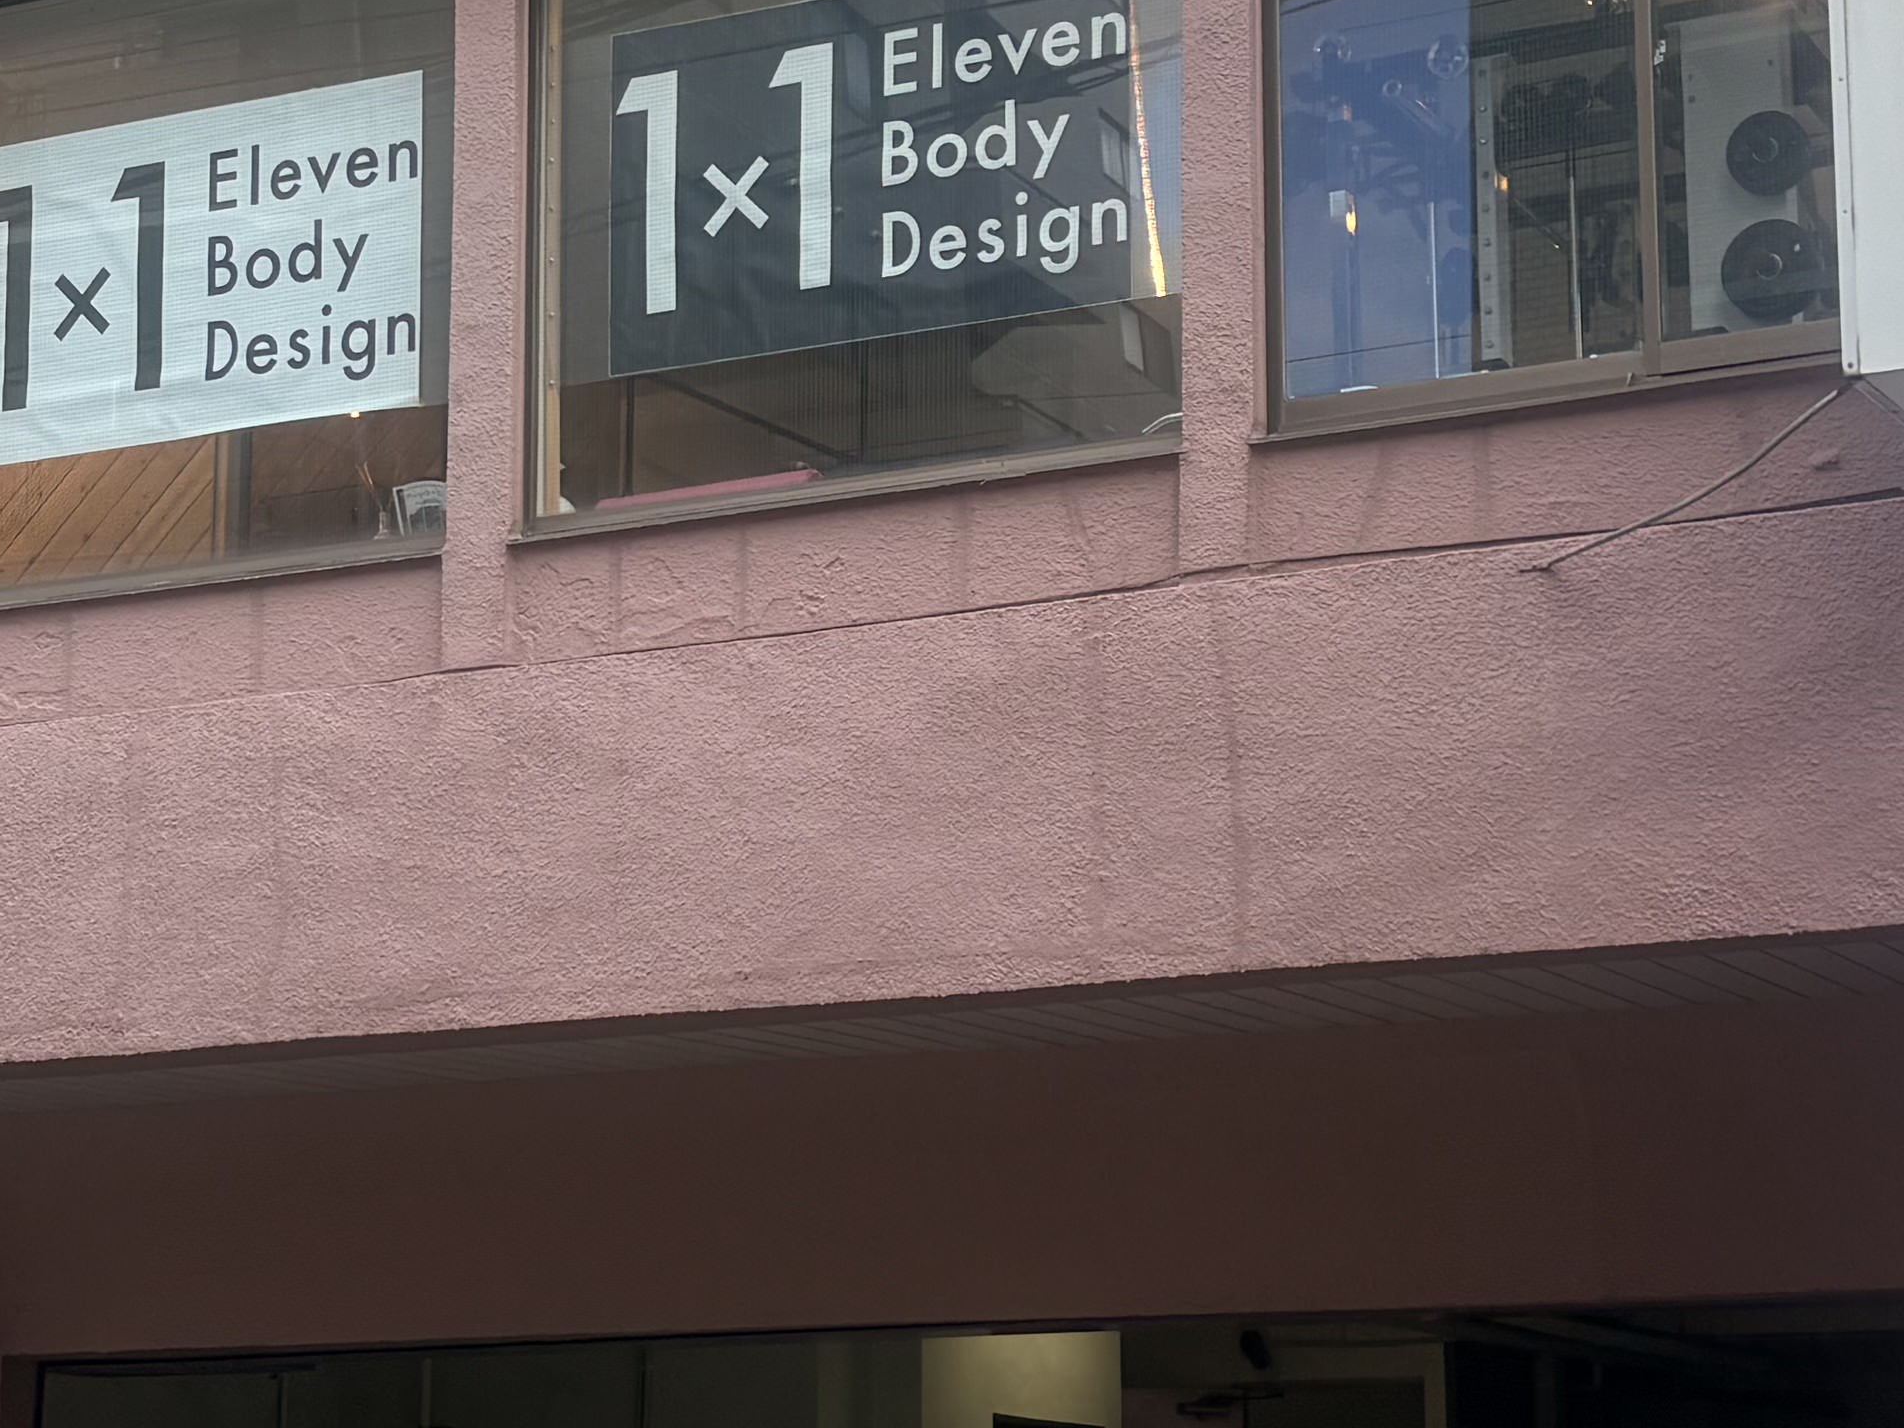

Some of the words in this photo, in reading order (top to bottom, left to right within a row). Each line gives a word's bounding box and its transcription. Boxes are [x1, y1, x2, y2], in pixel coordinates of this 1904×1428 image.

[882, 10, 1127, 97] Eleven
[208, 139, 419, 212] Eleven
[881, 99, 1071, 188] Body
[207, 218, 370, 297] Body
[881, 191, 1128, 279] Design
[204, 303, 417, 382] Design
